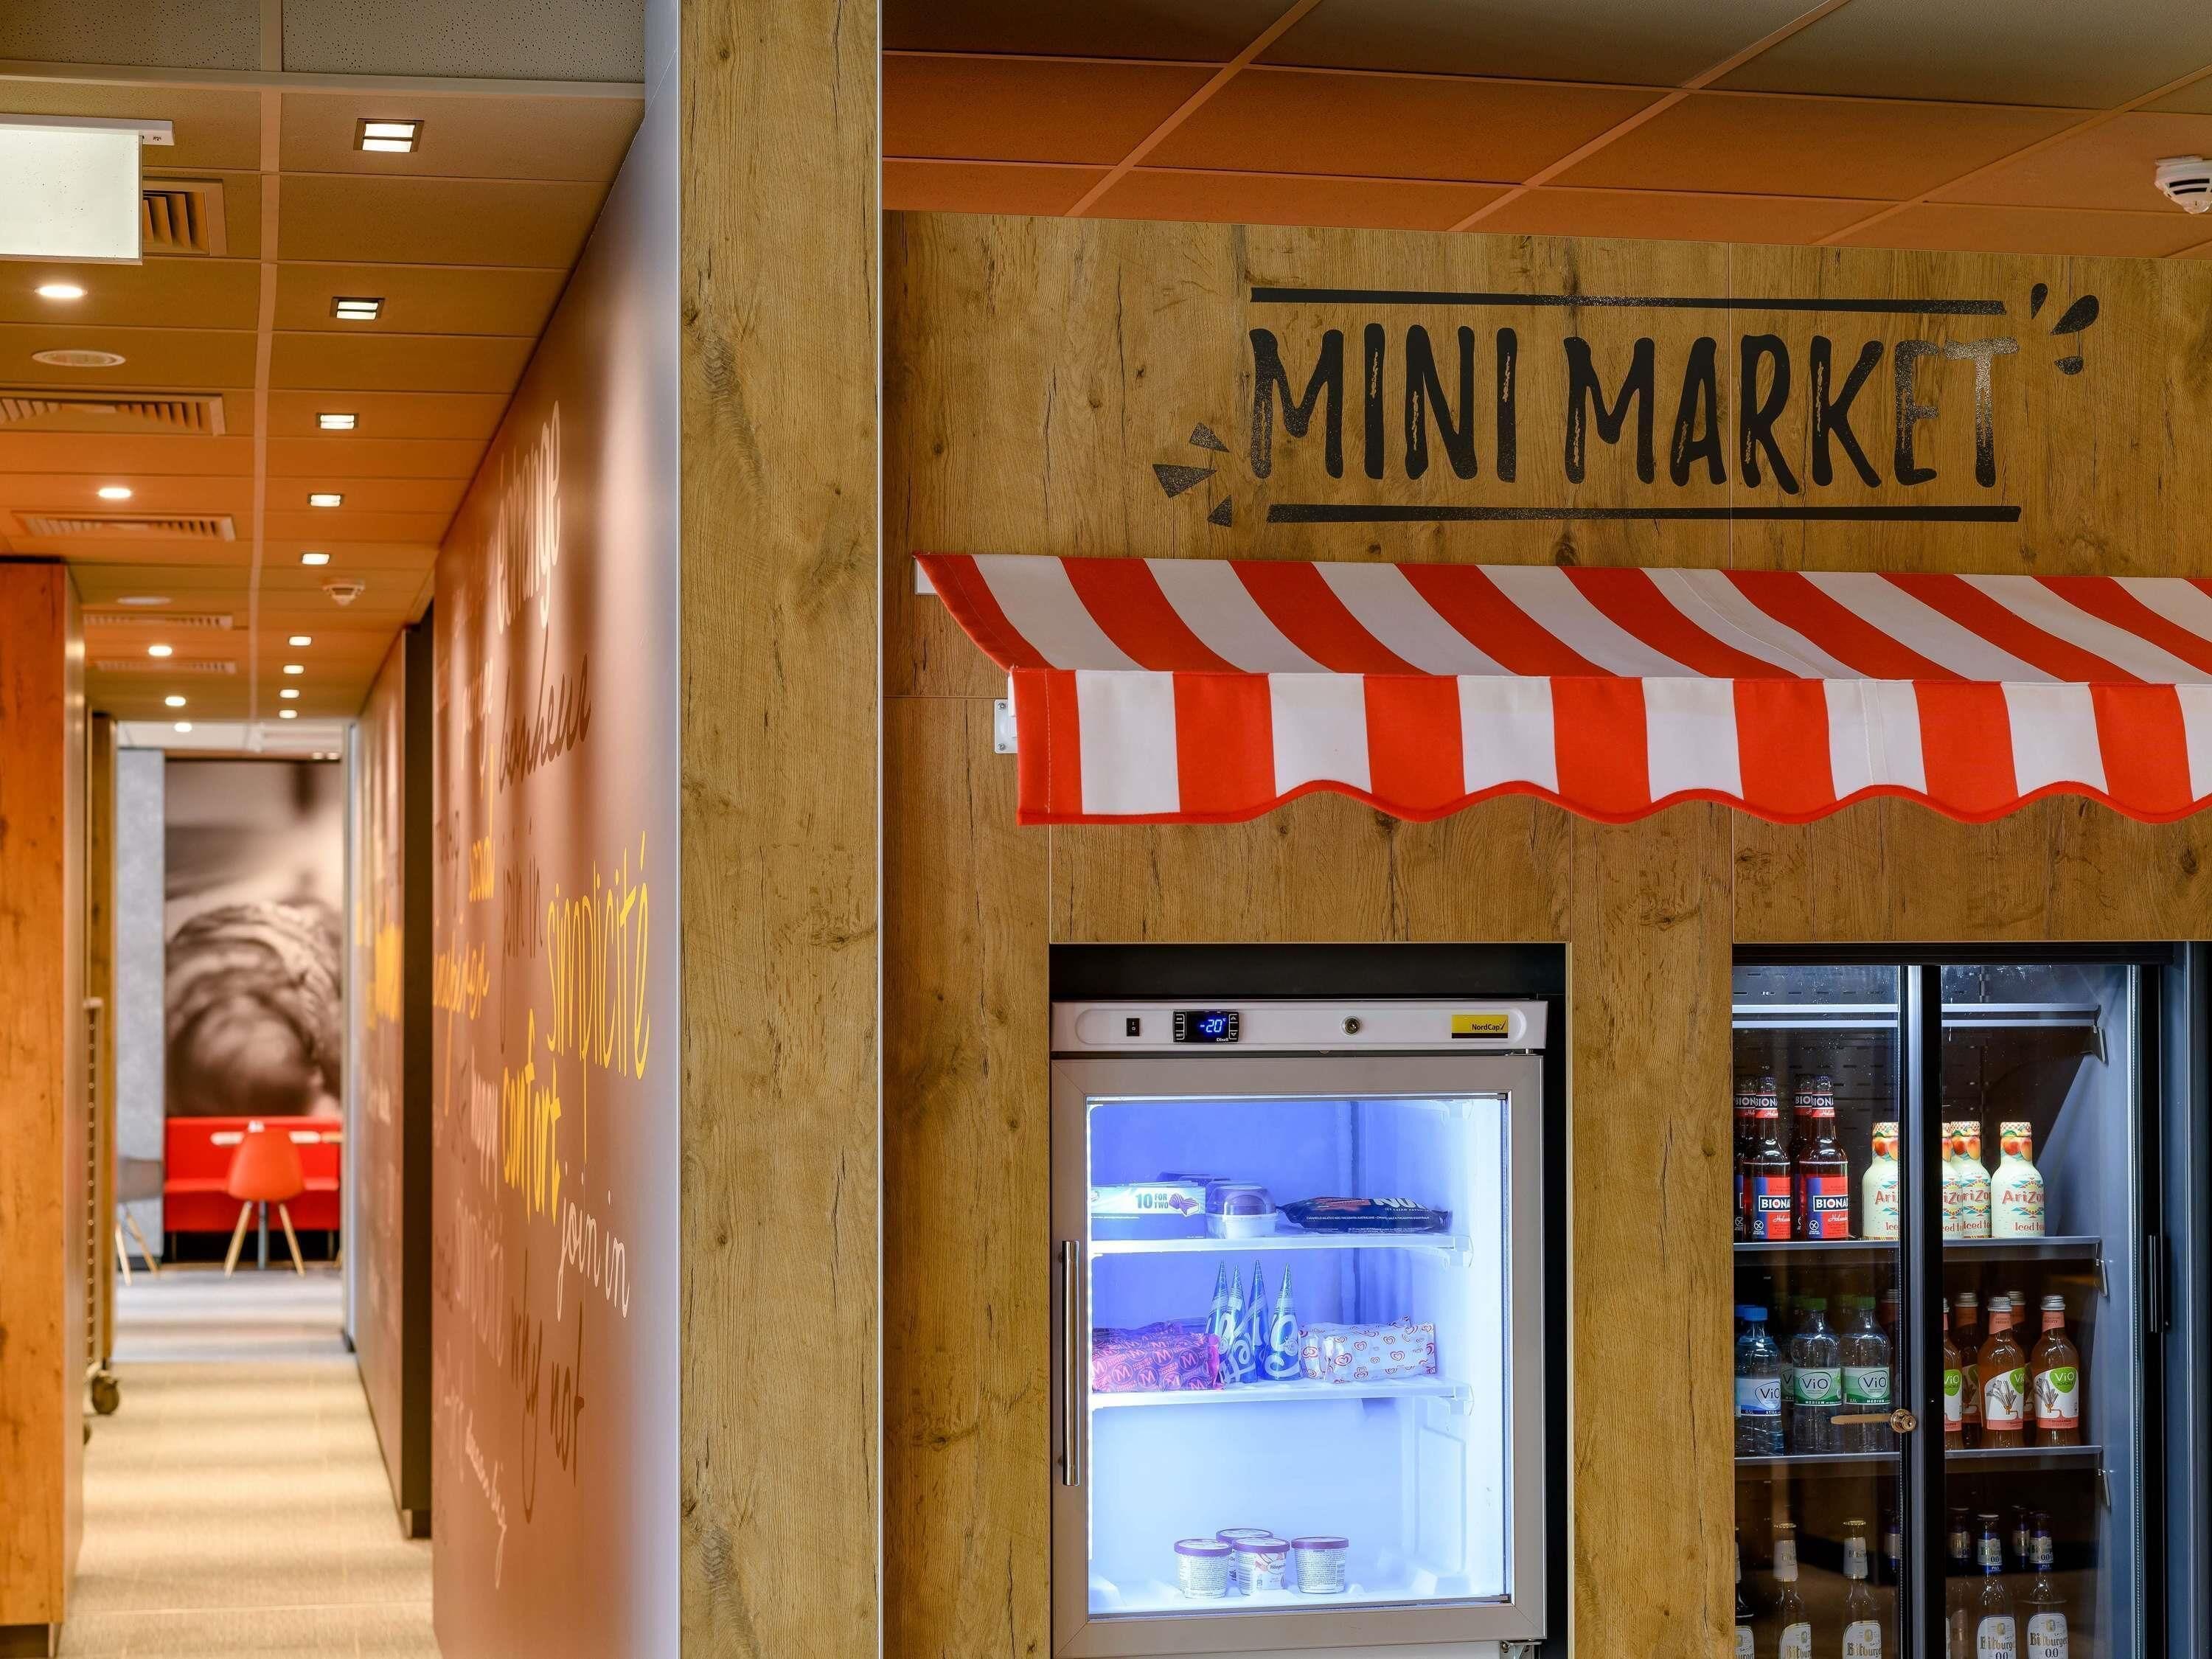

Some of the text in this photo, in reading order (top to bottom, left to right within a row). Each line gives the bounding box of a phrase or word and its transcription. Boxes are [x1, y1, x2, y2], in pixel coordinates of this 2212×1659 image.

[1248, 322, 2020, 495] MINI MARKET
[546, 830, 650, 1164] simplicité
[1472, 1023, 1500, 1032] NordCap
[502, 1008, 562, 1227] confort
[1136, 1192, 1167, 1209] 10 FOR
[1154, 1201, 1169, 1209] TWO
[1874, 1190, 1898, 1206] Ari
[557, 1161, 601, 1321] join
[605, 1189, 630, 1318] in
[1801, 1378, 1829, 1389] ViO
[1863, 1377, 1887, 1388] ViO
[2054, 1372, 2075, 1382] ViO
[511, 1248, 542, 1524] why
[550, 1301, 585, 1487] not
